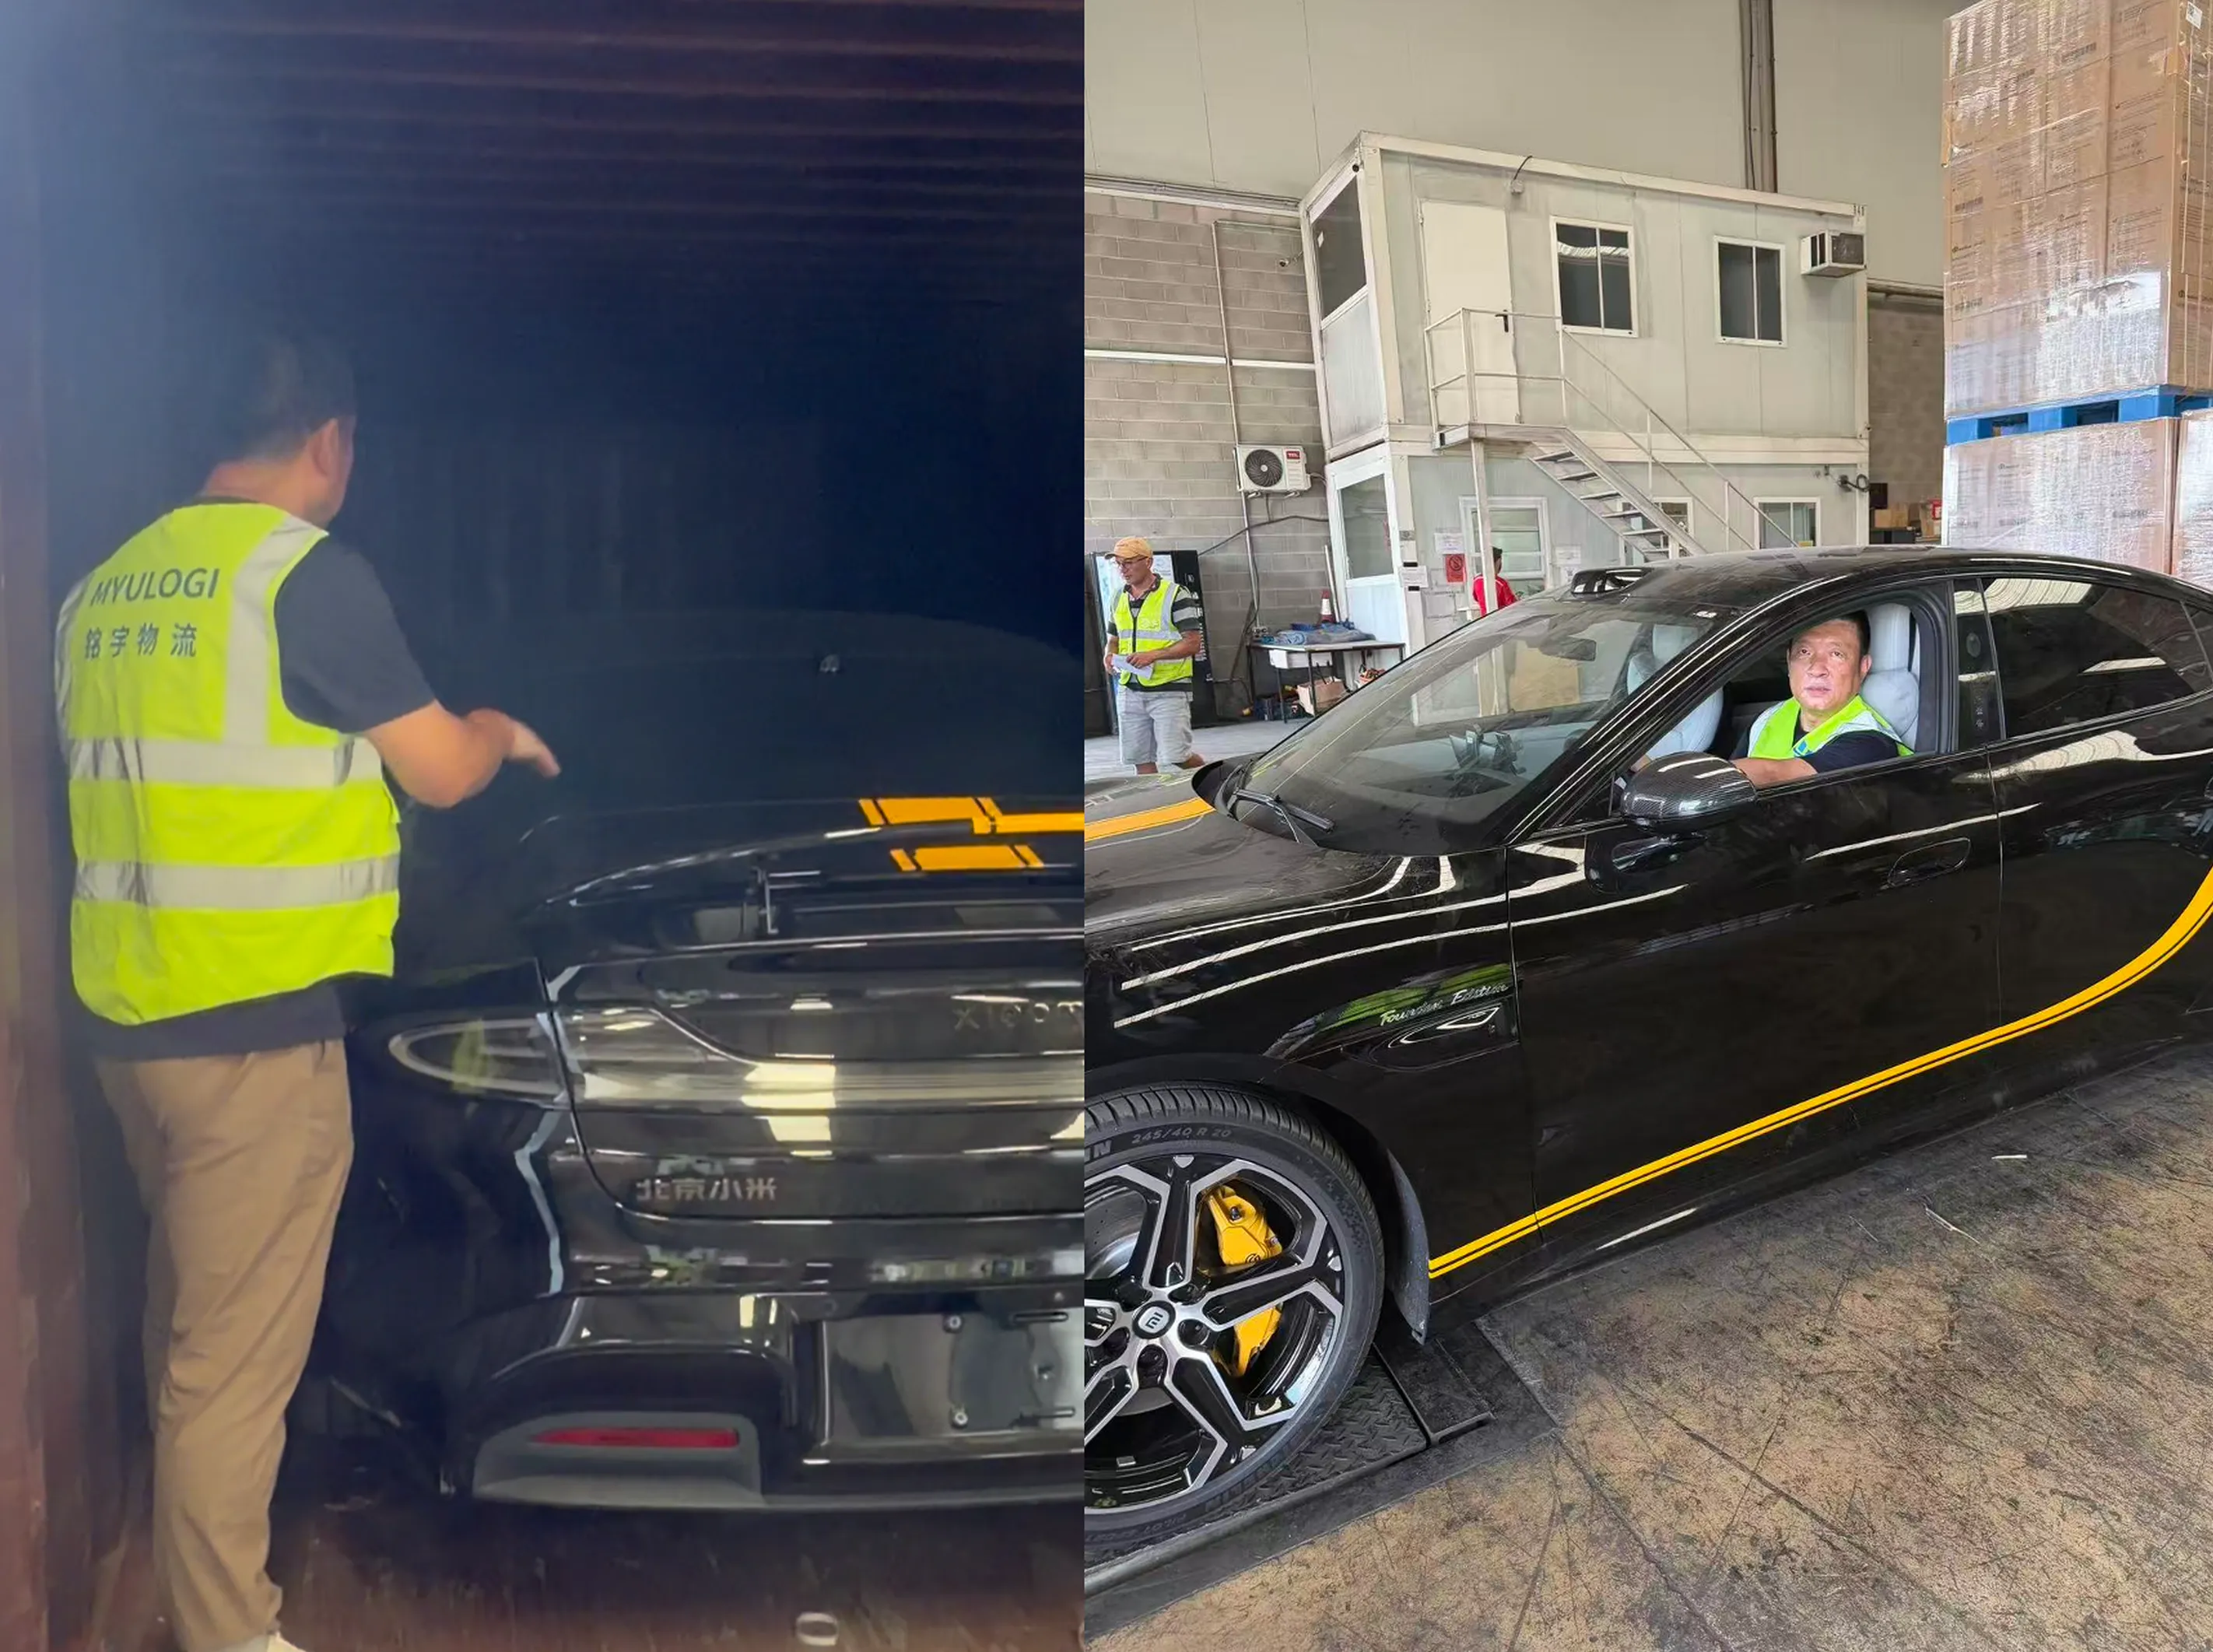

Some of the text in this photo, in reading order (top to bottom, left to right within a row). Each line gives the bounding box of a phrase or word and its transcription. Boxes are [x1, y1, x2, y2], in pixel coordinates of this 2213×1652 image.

[90, 568, 220, 606] MYULOGI
[1132, 1127, 1193, 1144] 245/40
[1196, 1128, 1208, 1136] R
[636, 1177, 777, 1201] 北京小米
